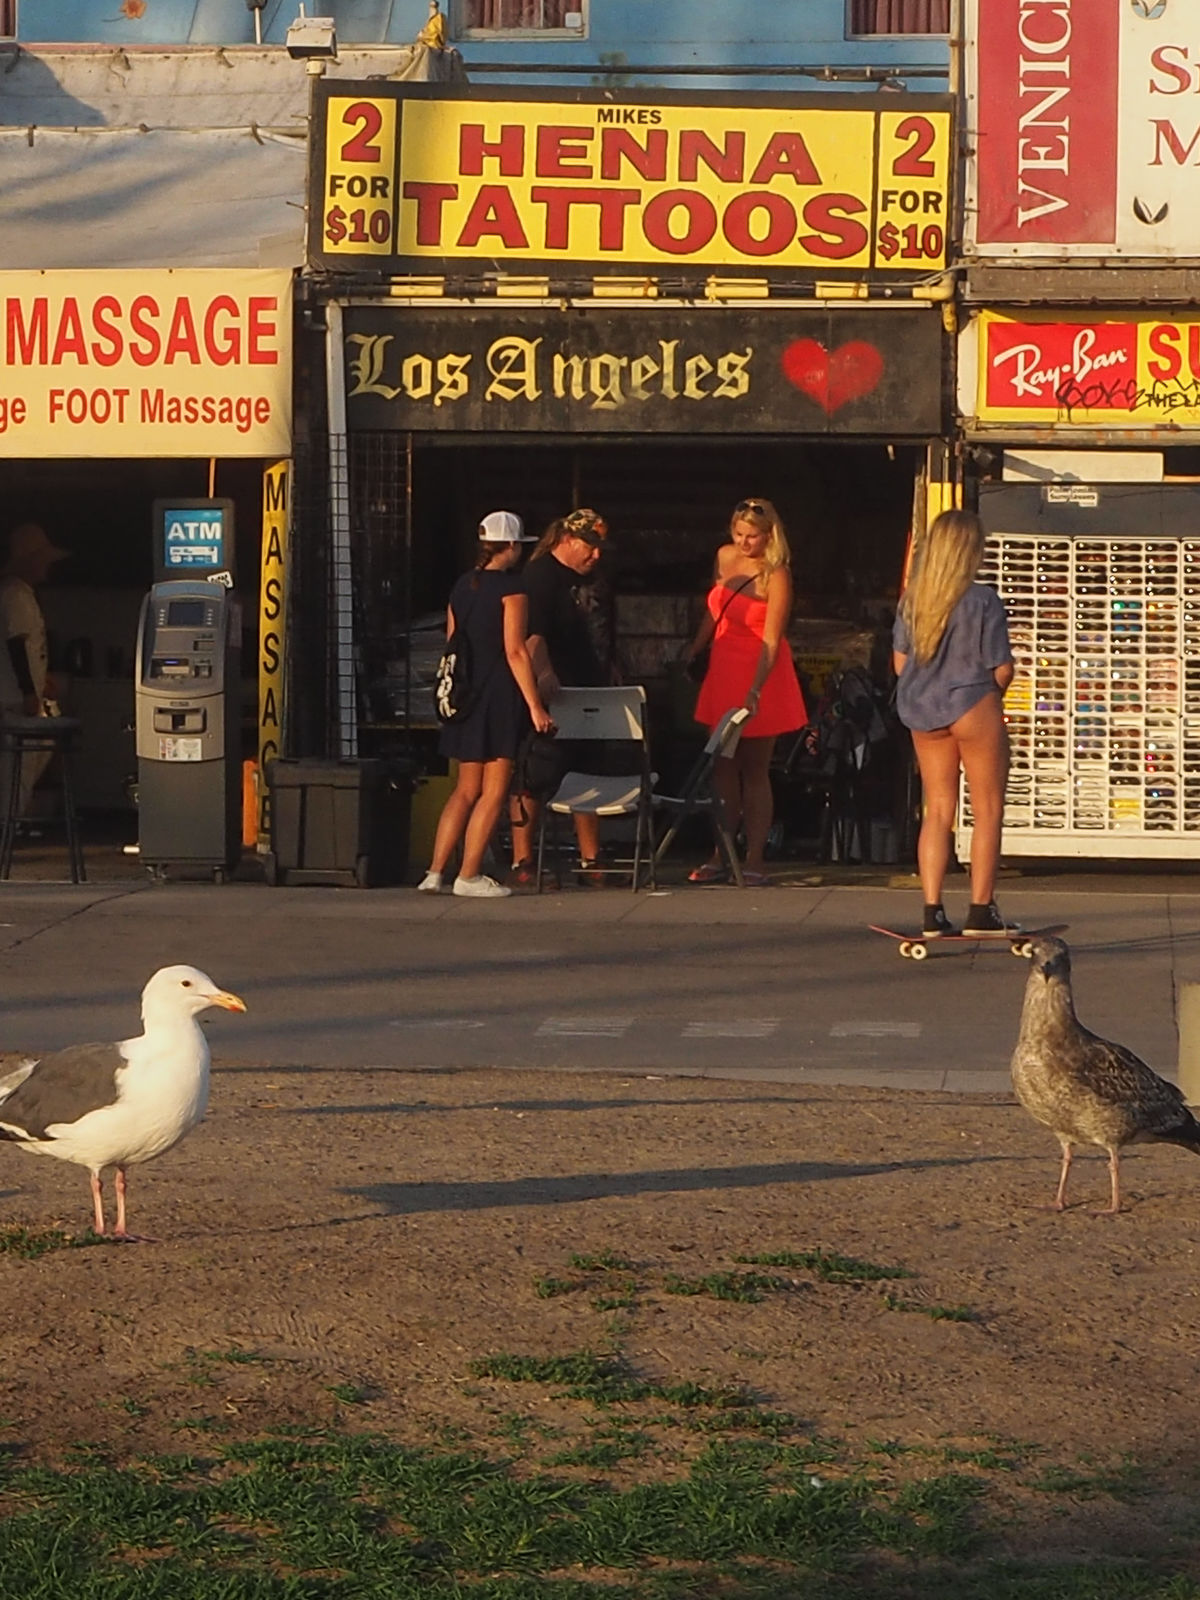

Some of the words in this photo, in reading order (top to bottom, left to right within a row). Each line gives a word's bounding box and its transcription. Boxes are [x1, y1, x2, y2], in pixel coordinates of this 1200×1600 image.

[1149, 45, 1200, 95] S
[341, 102, 383, 163] 2
[597, 108, 662, 125] MIKES
[1017, 0, 1072, 229] VENIC
[459, 123, 823, 185] HENNA
[892, 115, 936, 178] 2
[329, 175, 390, 199] FOR
[881, 189, 942, 214] FOR
[325, 205, 391, 247] $10
[403, 182, 870, 260] TATTOOS
[877, 222, 943, 262] $10
[6, 294, 279, 367] MASSAGE
[346, 333, 473, 407] Los
[484, 336, 753, 410] Angeles
[49, 388, 131, 425] FOOT
[139, 387, 272, 434] Massage
[167, 522, 222, 541] ATM
